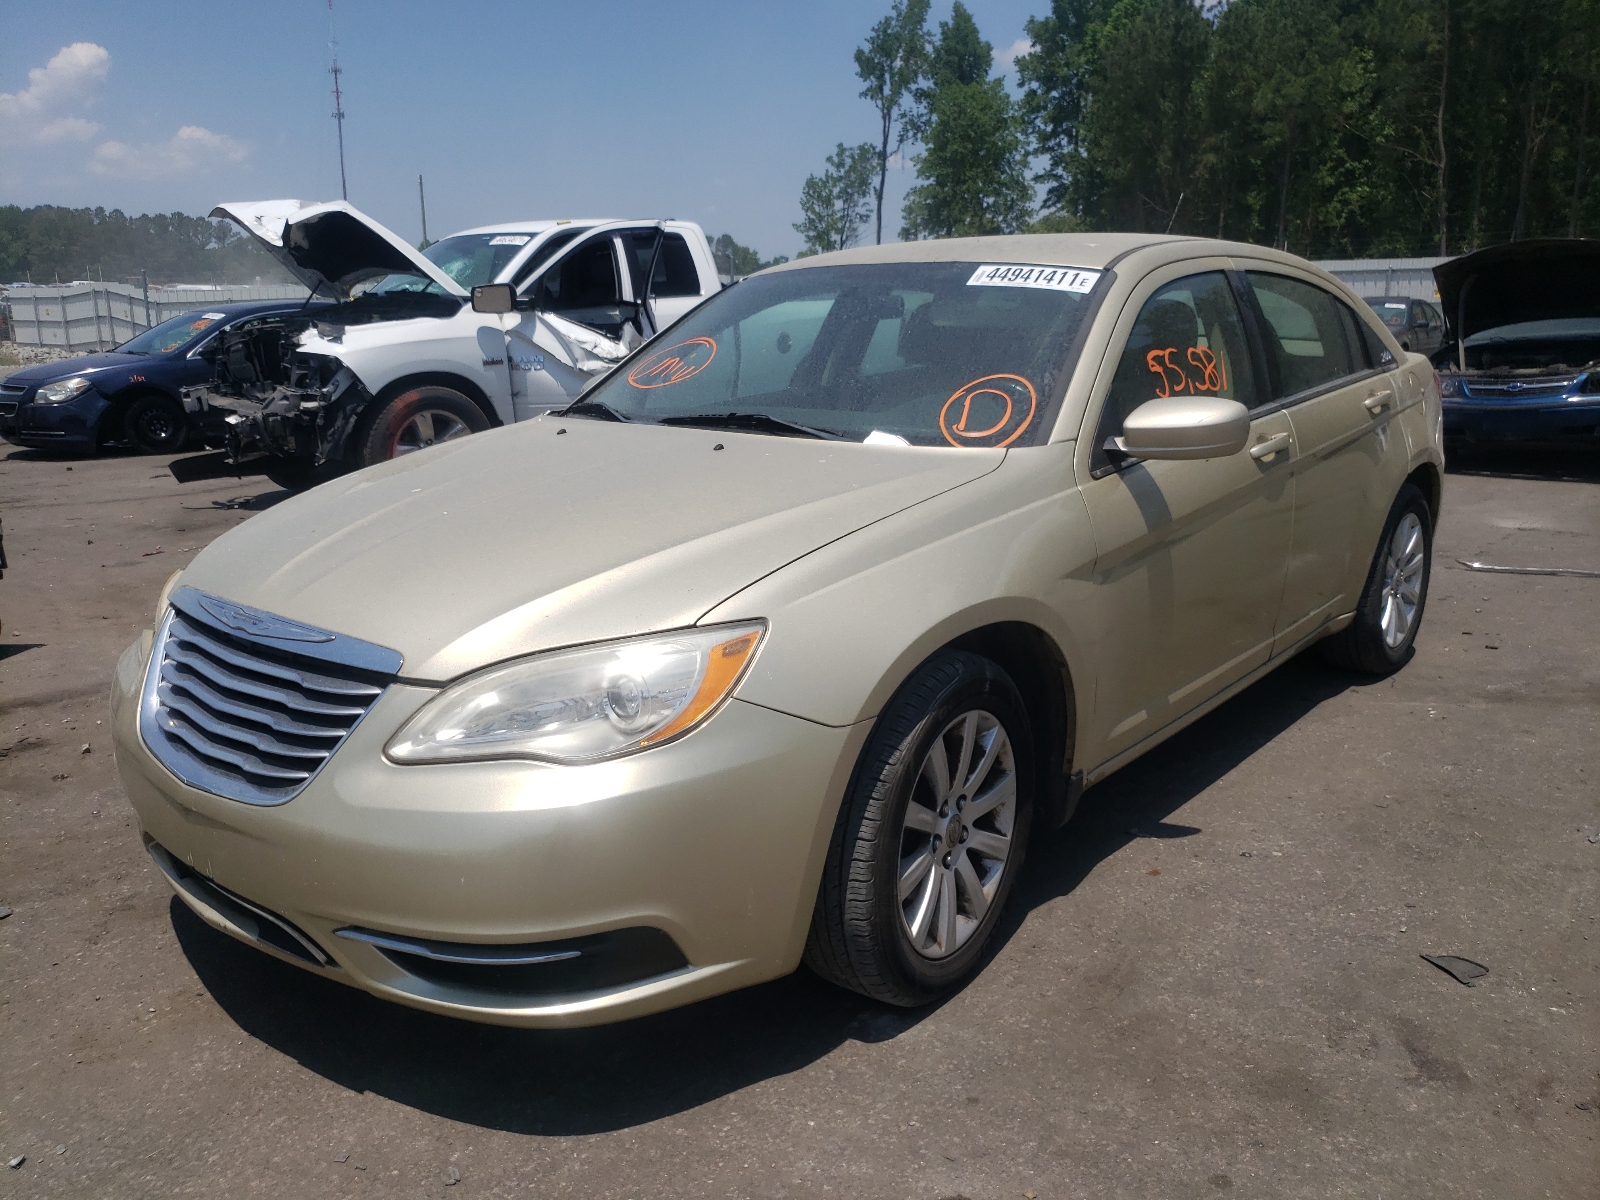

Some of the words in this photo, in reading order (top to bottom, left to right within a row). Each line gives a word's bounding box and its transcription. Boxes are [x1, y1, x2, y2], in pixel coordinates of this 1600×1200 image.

[985, 267, 1080, 287] 44941411
[1079, 278, 1089, 287] E
[952, 388, 1013, 438] D
